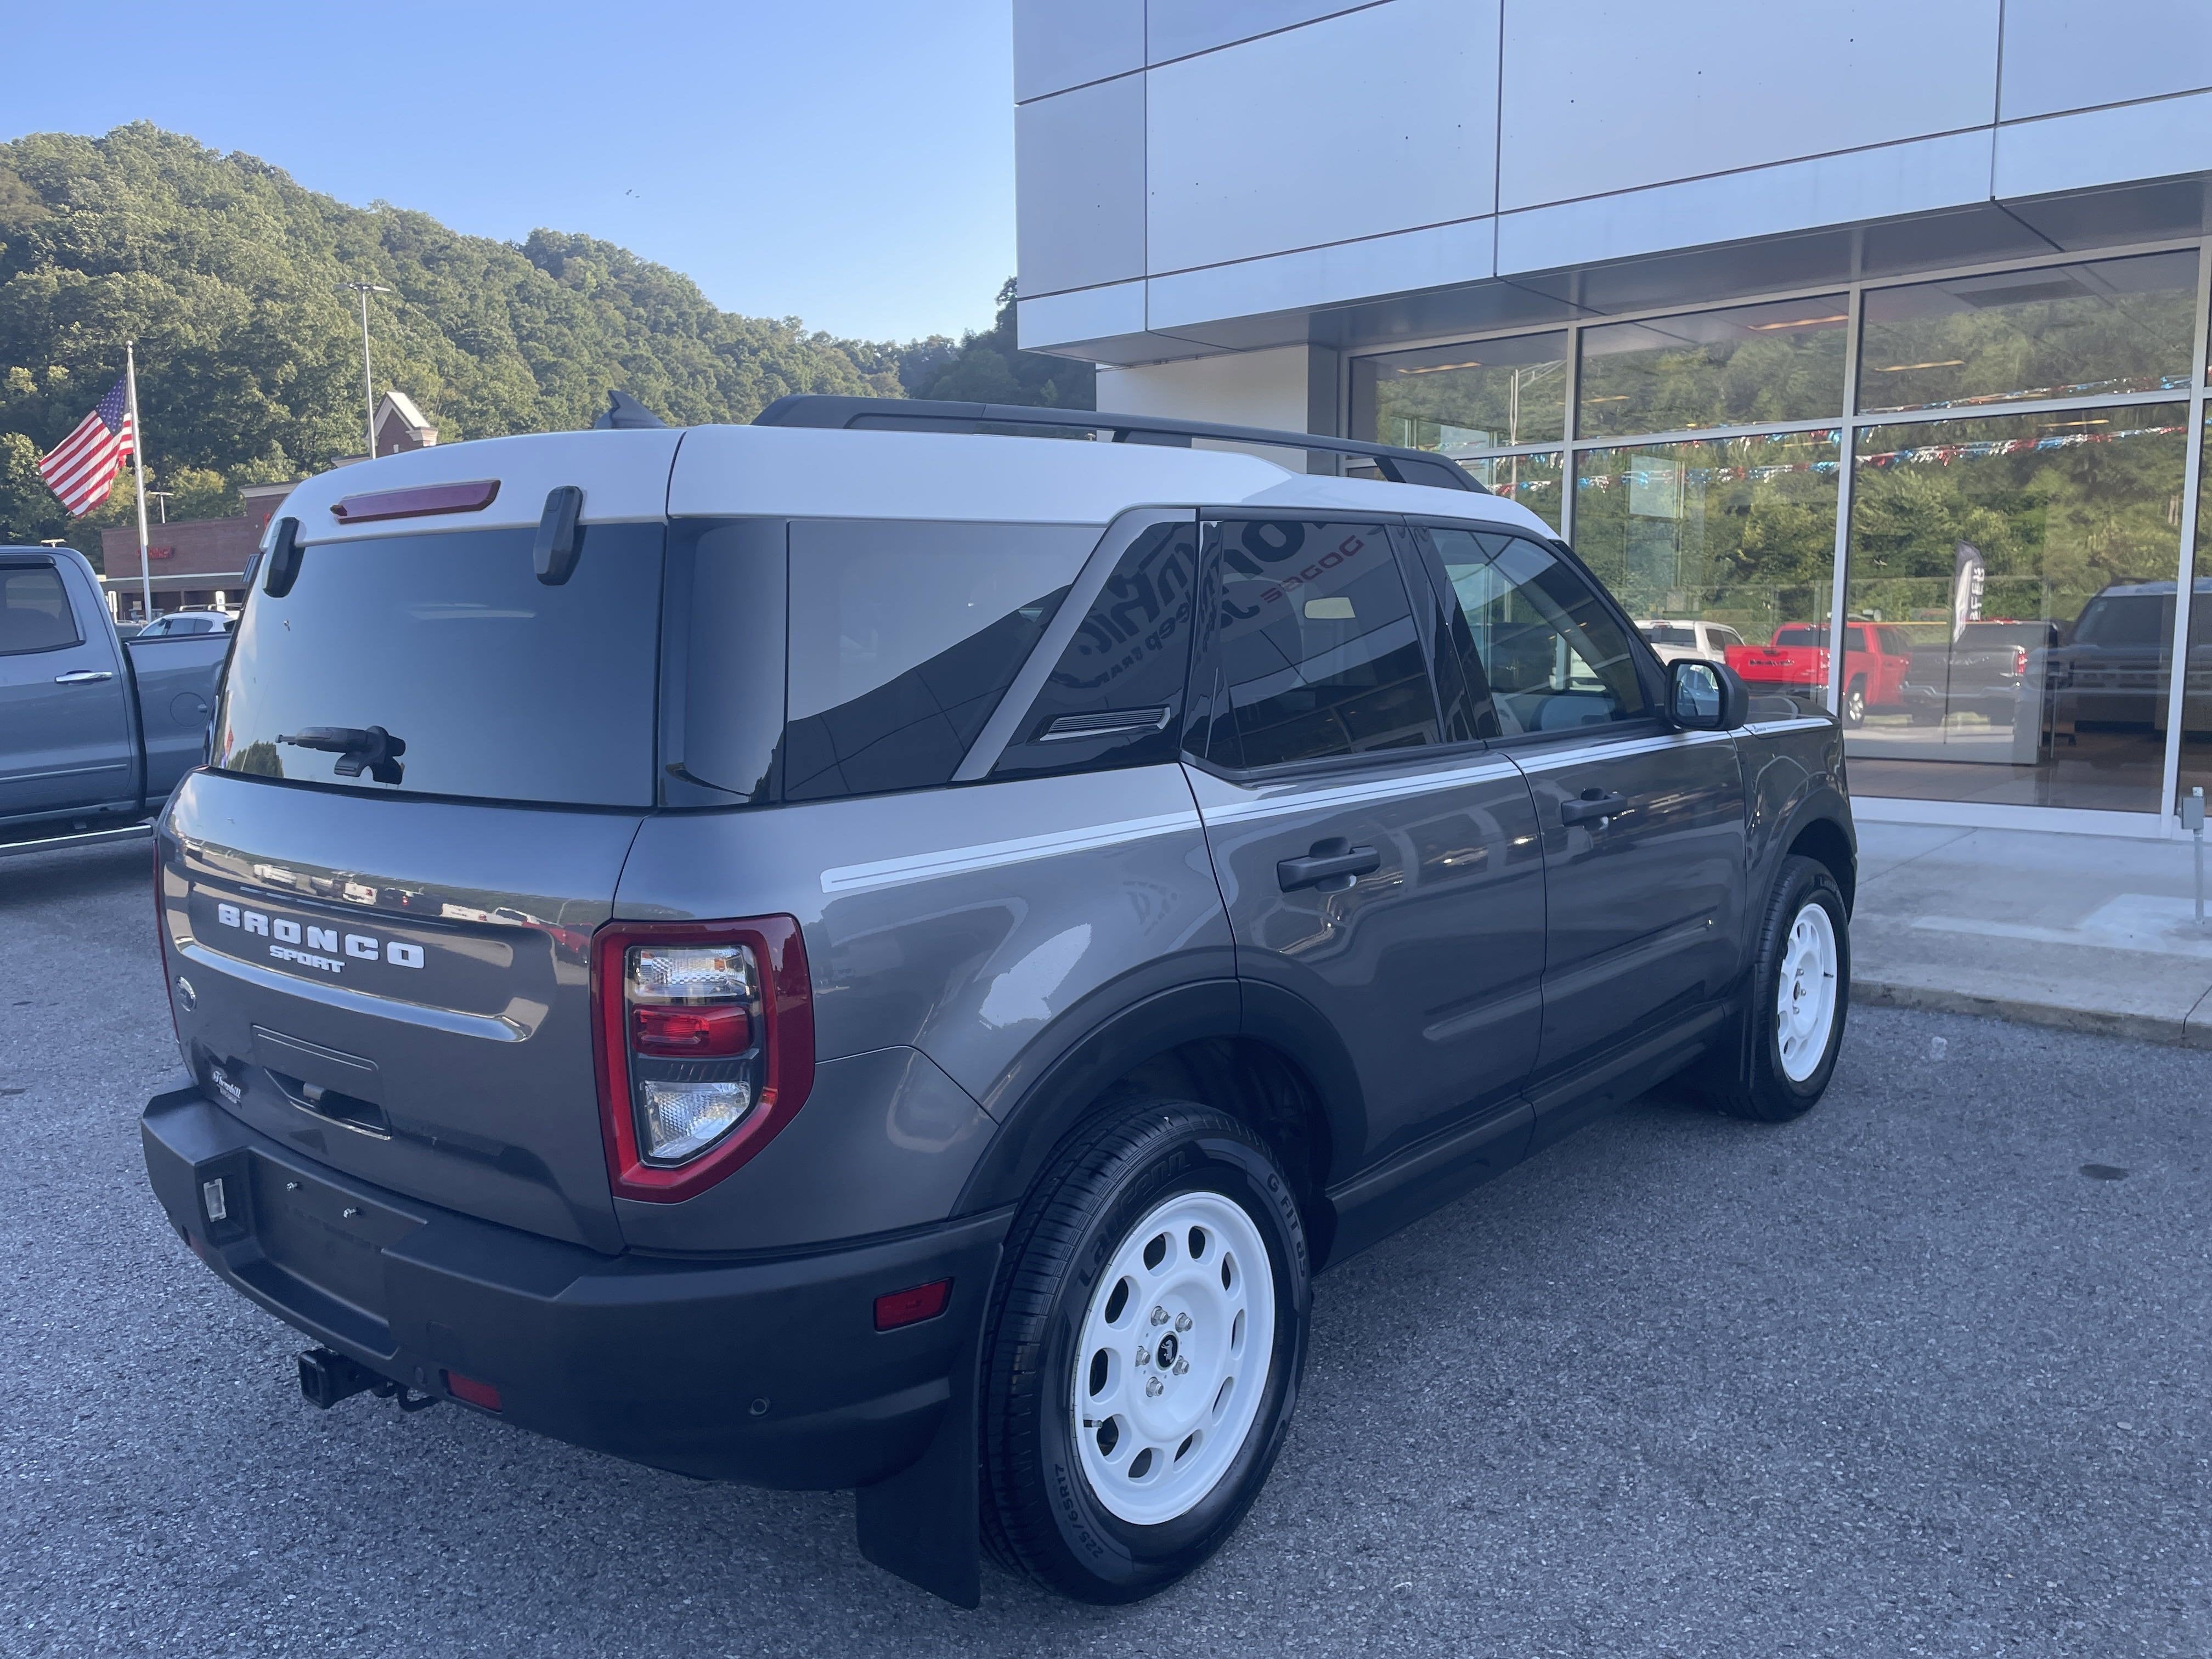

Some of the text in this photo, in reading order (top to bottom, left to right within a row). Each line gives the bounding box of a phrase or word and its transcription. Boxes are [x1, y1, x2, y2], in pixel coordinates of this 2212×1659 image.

[218, 903, 425, 969] BRONCO
[269, 945, 346, 973] SPORT
[1280, 1195, 1300, 1231] FIT
[1054, 1463, 1104, 1559] 225/65R17
